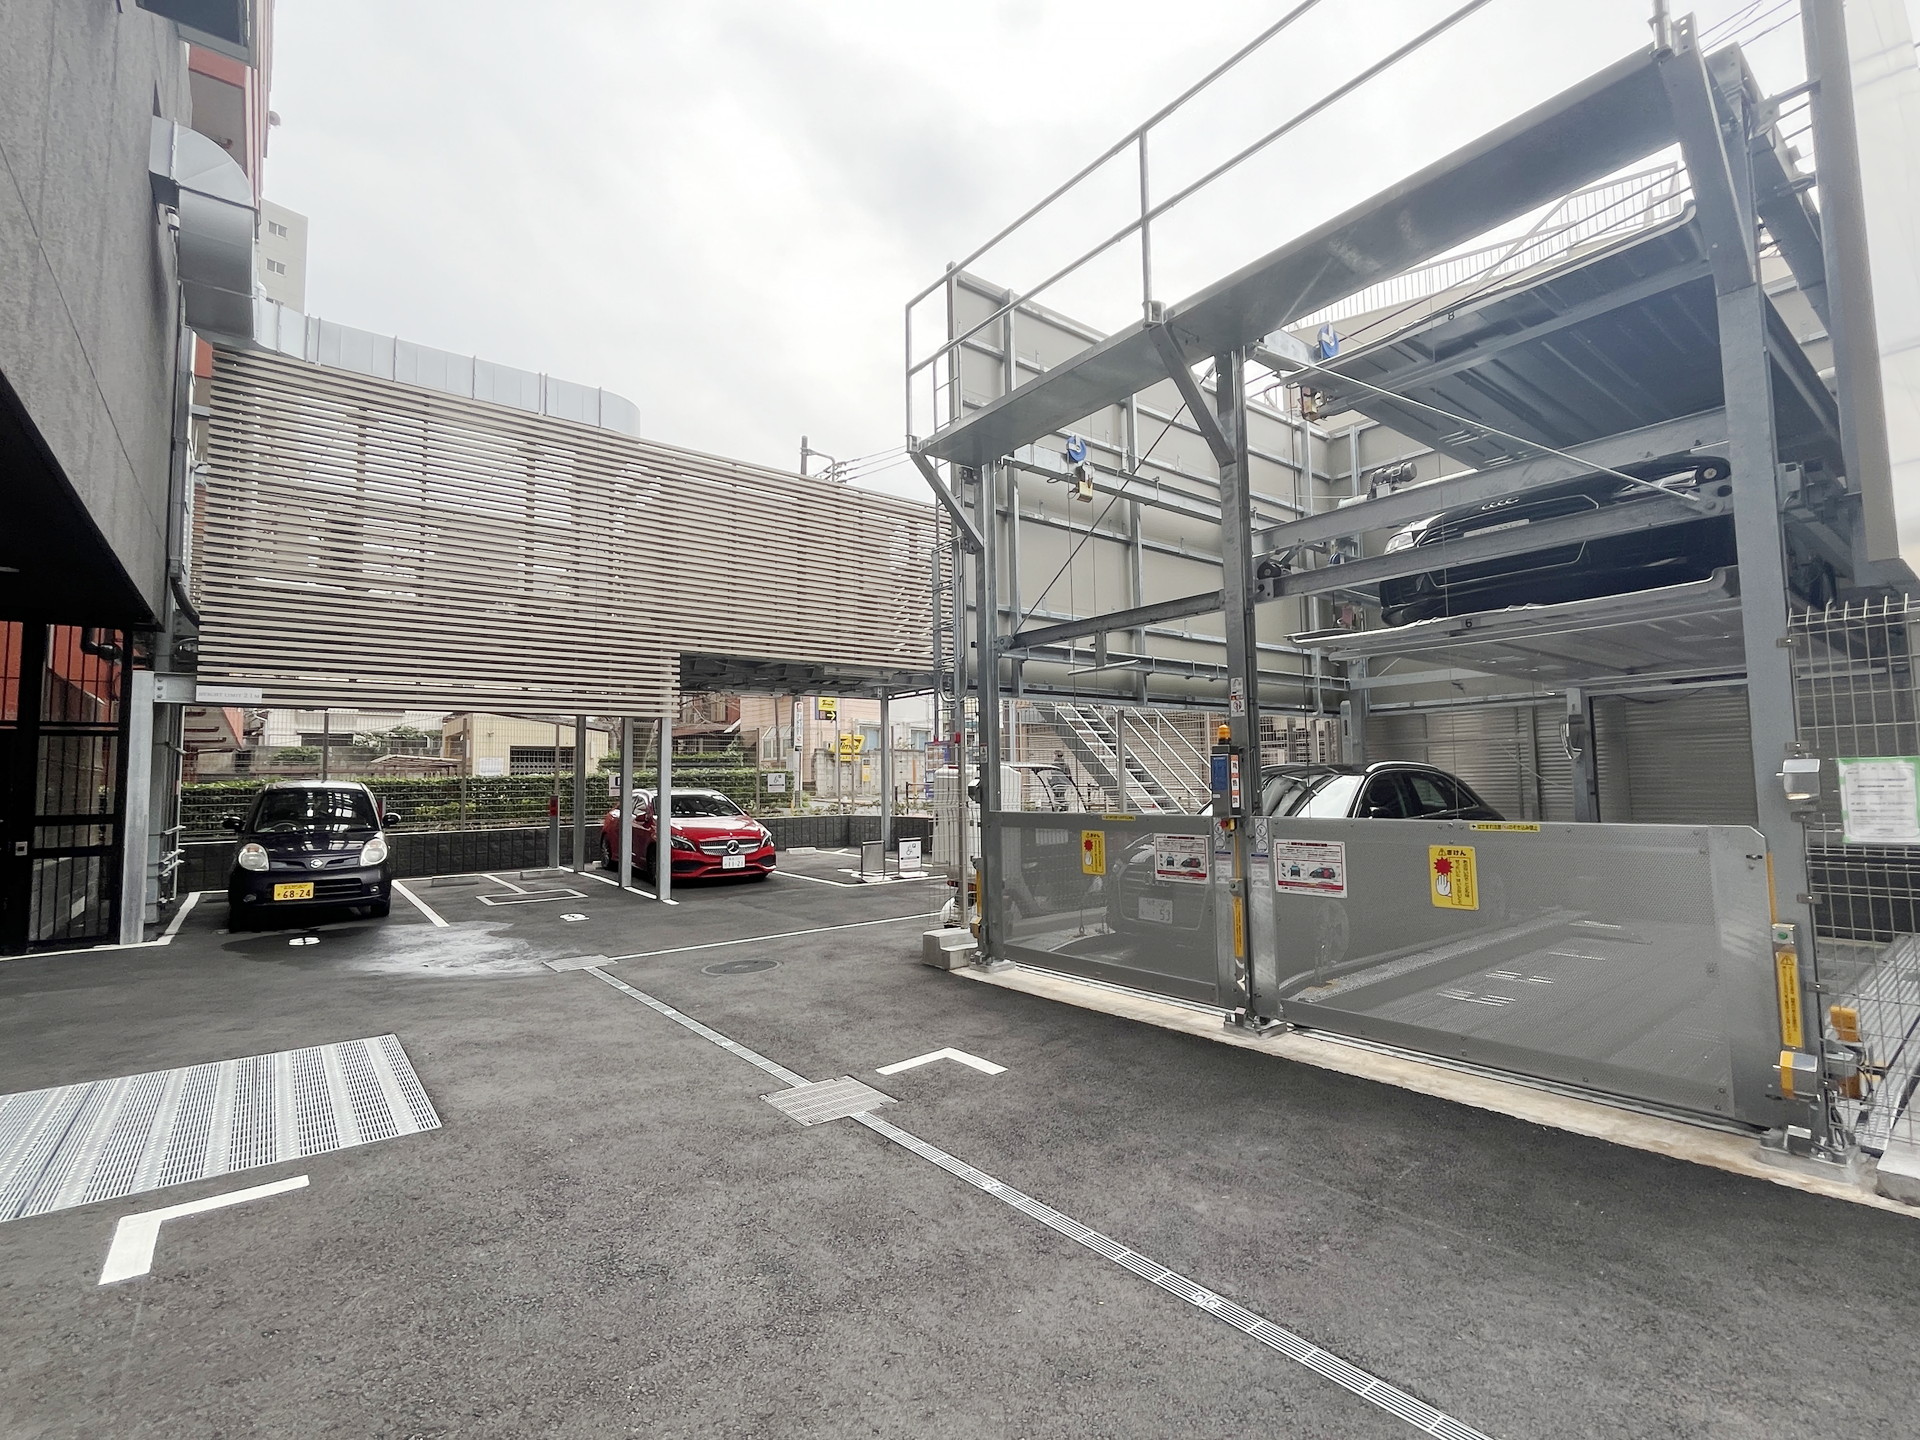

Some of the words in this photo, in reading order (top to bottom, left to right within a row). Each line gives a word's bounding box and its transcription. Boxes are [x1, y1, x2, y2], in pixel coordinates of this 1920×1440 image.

[1466, 618, 1473, 627] 6
[1446, 849, 1467, 857] きけん
